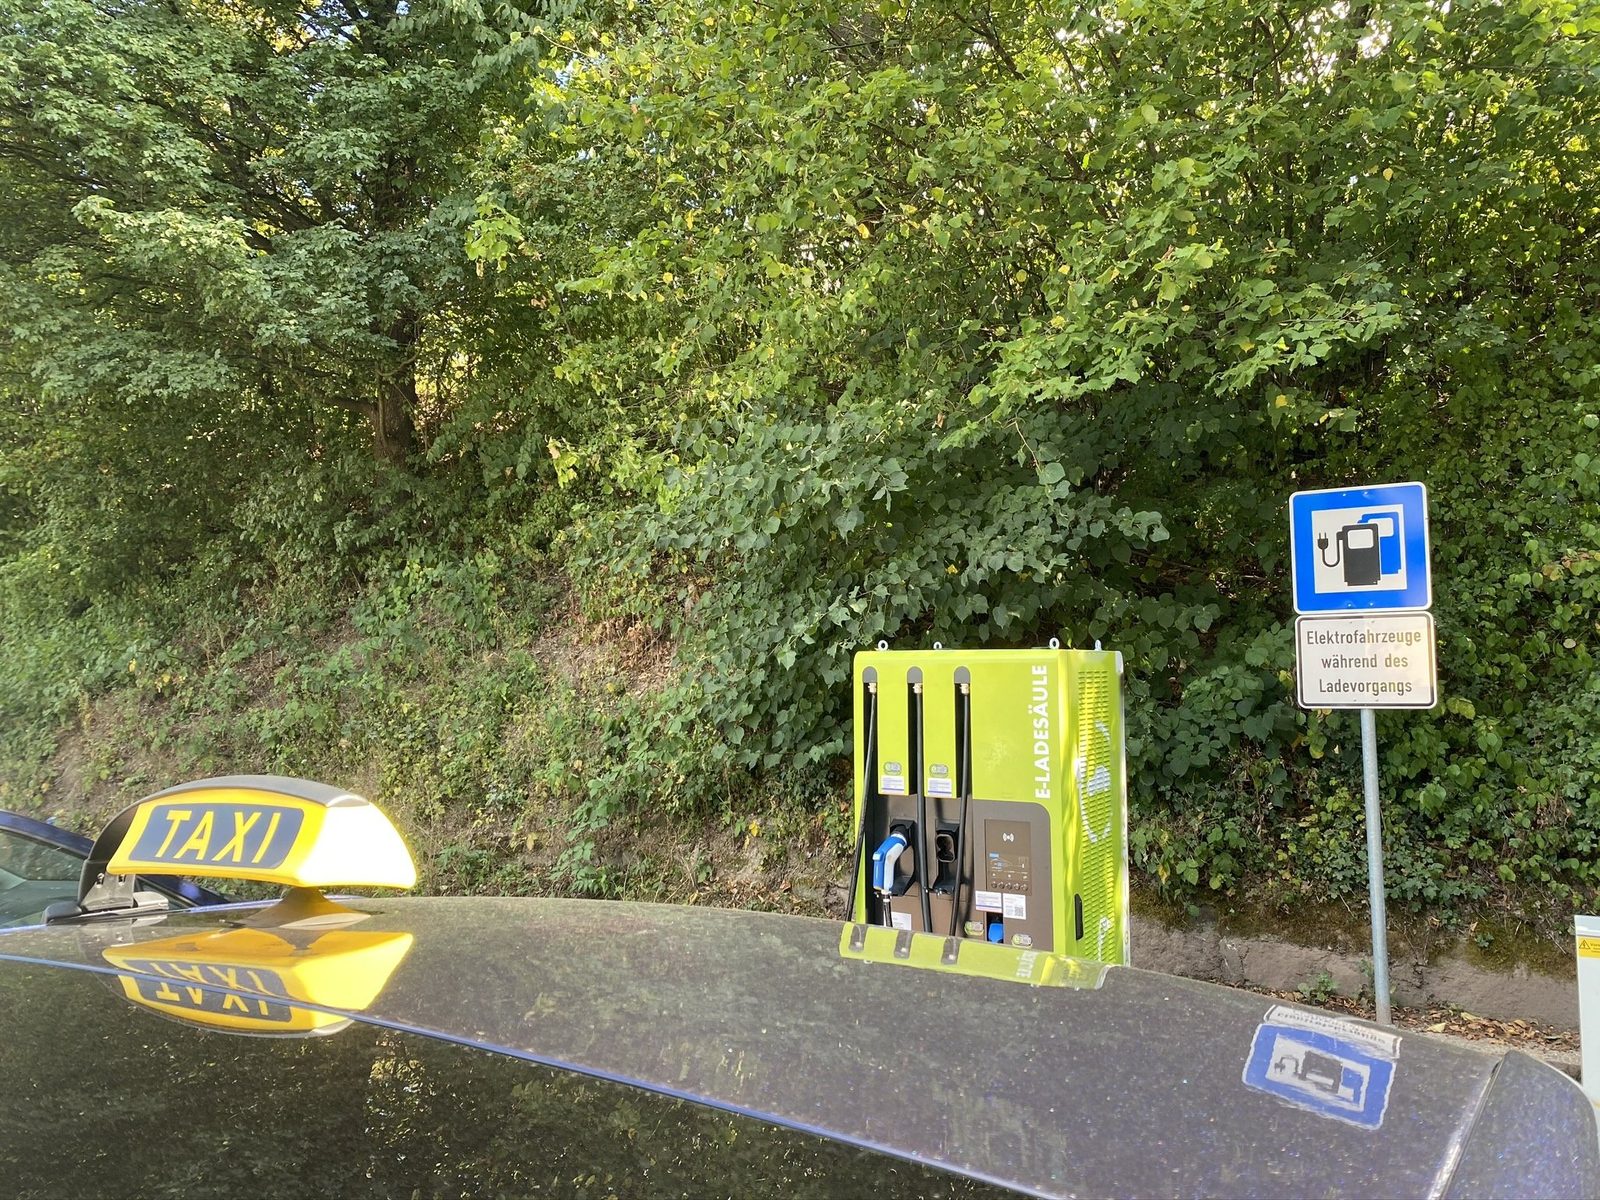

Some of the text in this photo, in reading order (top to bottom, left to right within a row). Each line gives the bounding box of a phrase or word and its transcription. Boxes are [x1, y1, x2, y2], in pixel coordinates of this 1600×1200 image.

[1306, 629, 1421, 646] Elektrofahrzeuge
[1321, 654, 1409, 669] während des
[1319, 678, 1412, 696] Ladevorgangs
[1028, 665, 1051, 799] E-LADESÄULE
[154, 810, 281, 863] TAXI
